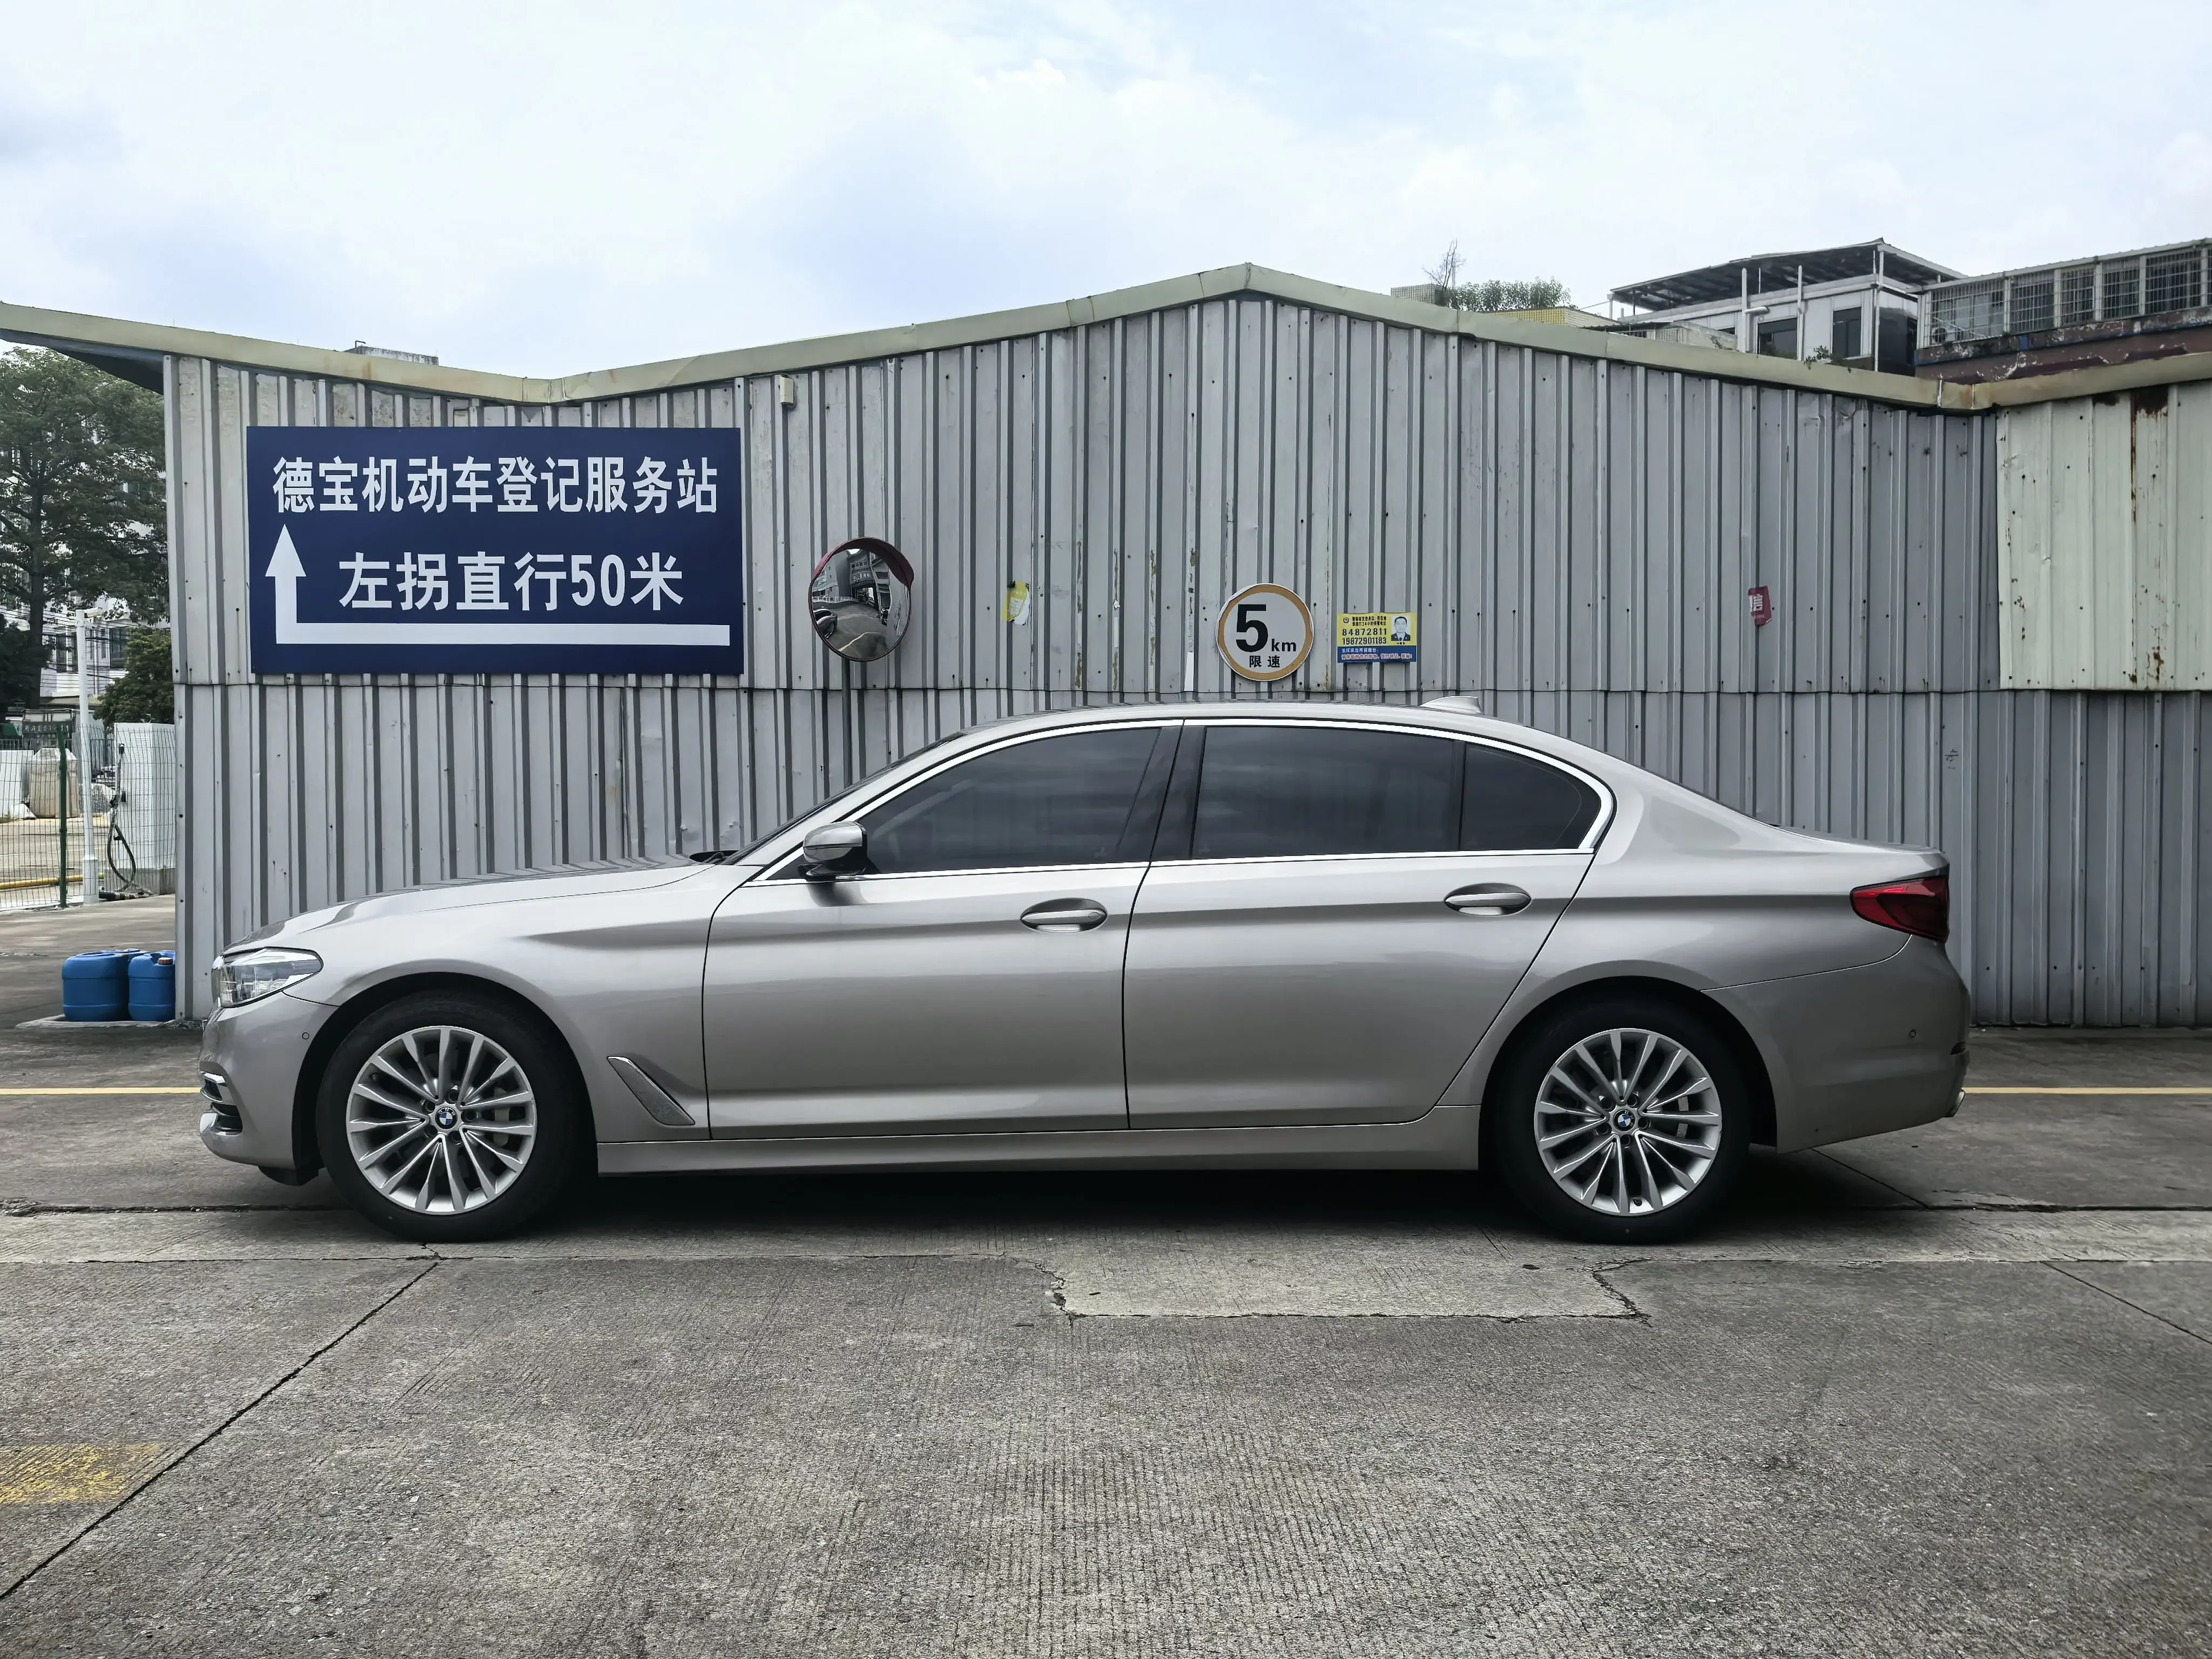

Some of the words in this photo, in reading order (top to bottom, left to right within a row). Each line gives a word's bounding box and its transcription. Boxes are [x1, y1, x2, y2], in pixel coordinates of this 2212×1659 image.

[273, 456, 717, 513] 德宝机动车登记服务站
[339, 551, 683, 610] 左拐直行50米
[1342, 628, 1387, 636] 84872811
[1249, 655, 1280, 668] 限速
